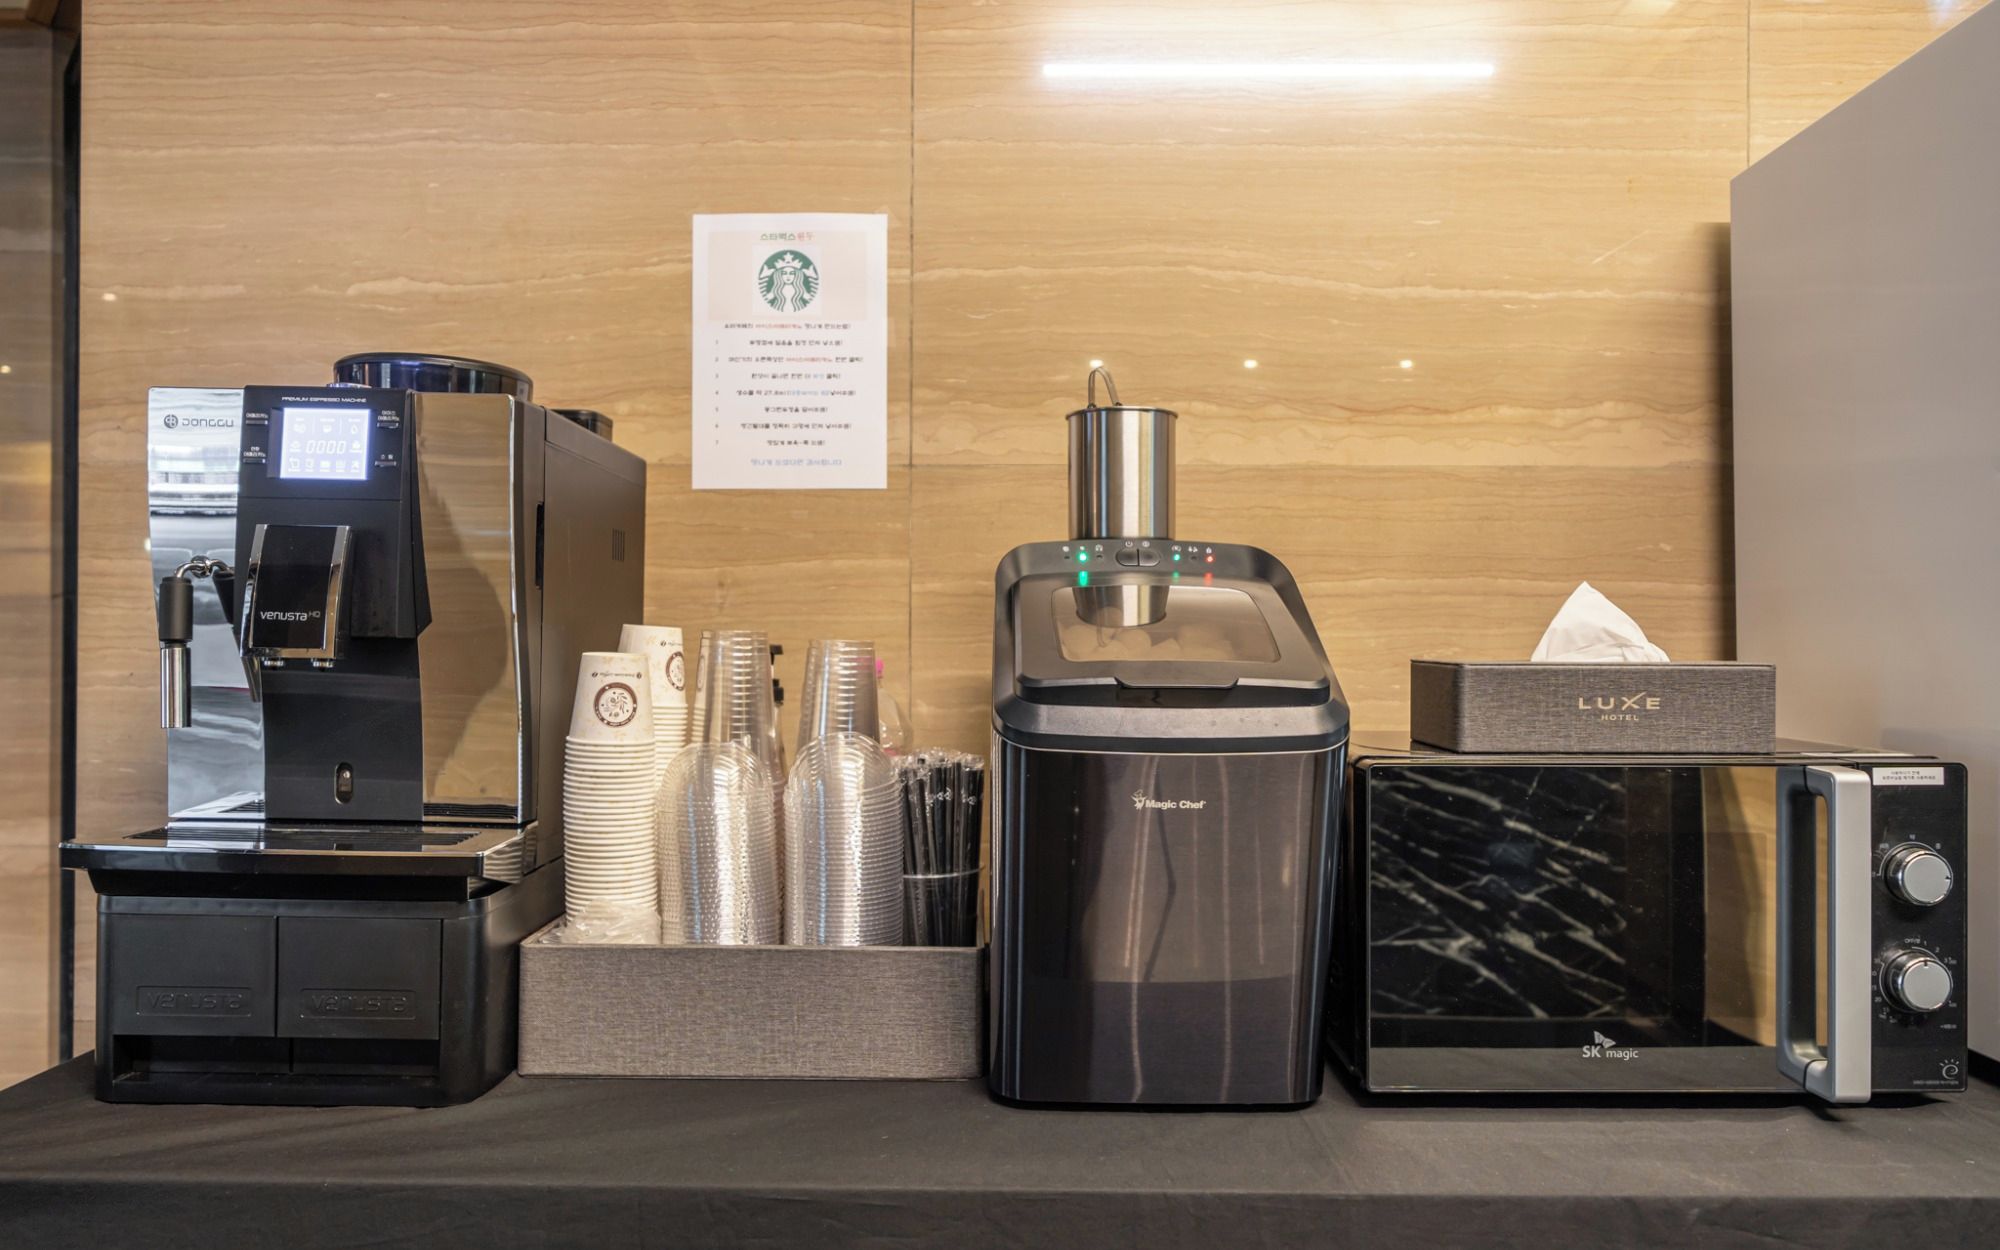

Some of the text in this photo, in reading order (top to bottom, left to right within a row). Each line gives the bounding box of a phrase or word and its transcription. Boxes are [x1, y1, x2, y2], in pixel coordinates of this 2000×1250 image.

[1578, 691, 1661, 711] LUXE
[1145, 799, 1205, 810] Magic Chef
[1582, 1045, 1640, 1061] SK magic
